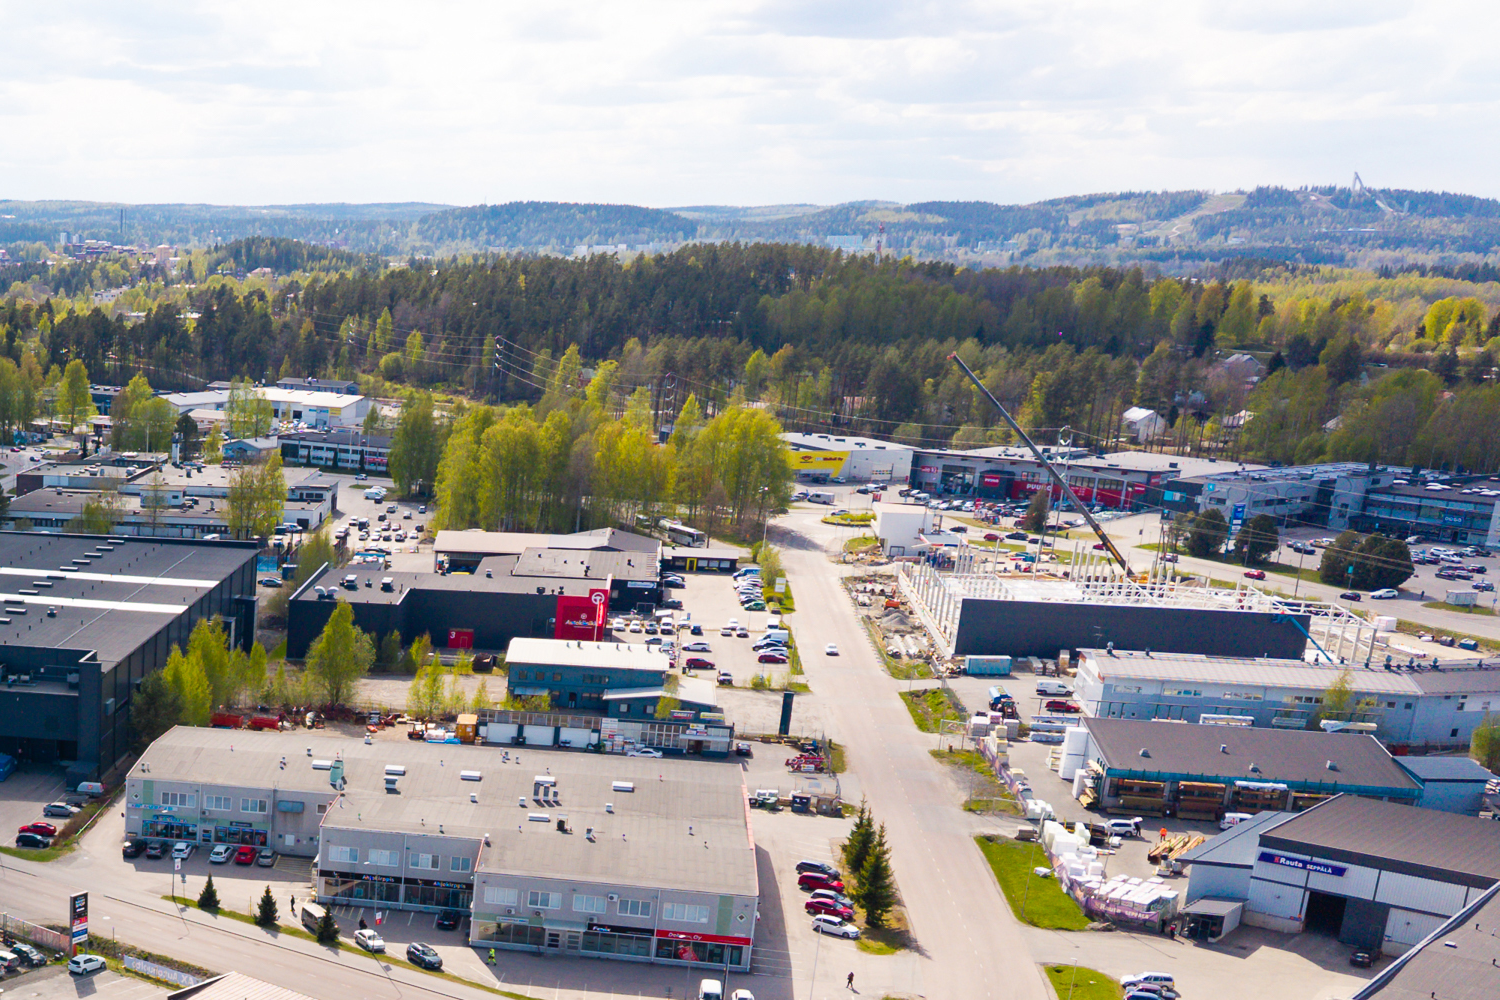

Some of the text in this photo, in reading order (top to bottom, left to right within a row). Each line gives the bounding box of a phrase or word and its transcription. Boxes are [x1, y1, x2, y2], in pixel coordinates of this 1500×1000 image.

[1026, 483, 1051, 491] PUUO
[450, 631, 456, 639] 3
[1306, 864, 1332, 873] SEPPÄLÄ
